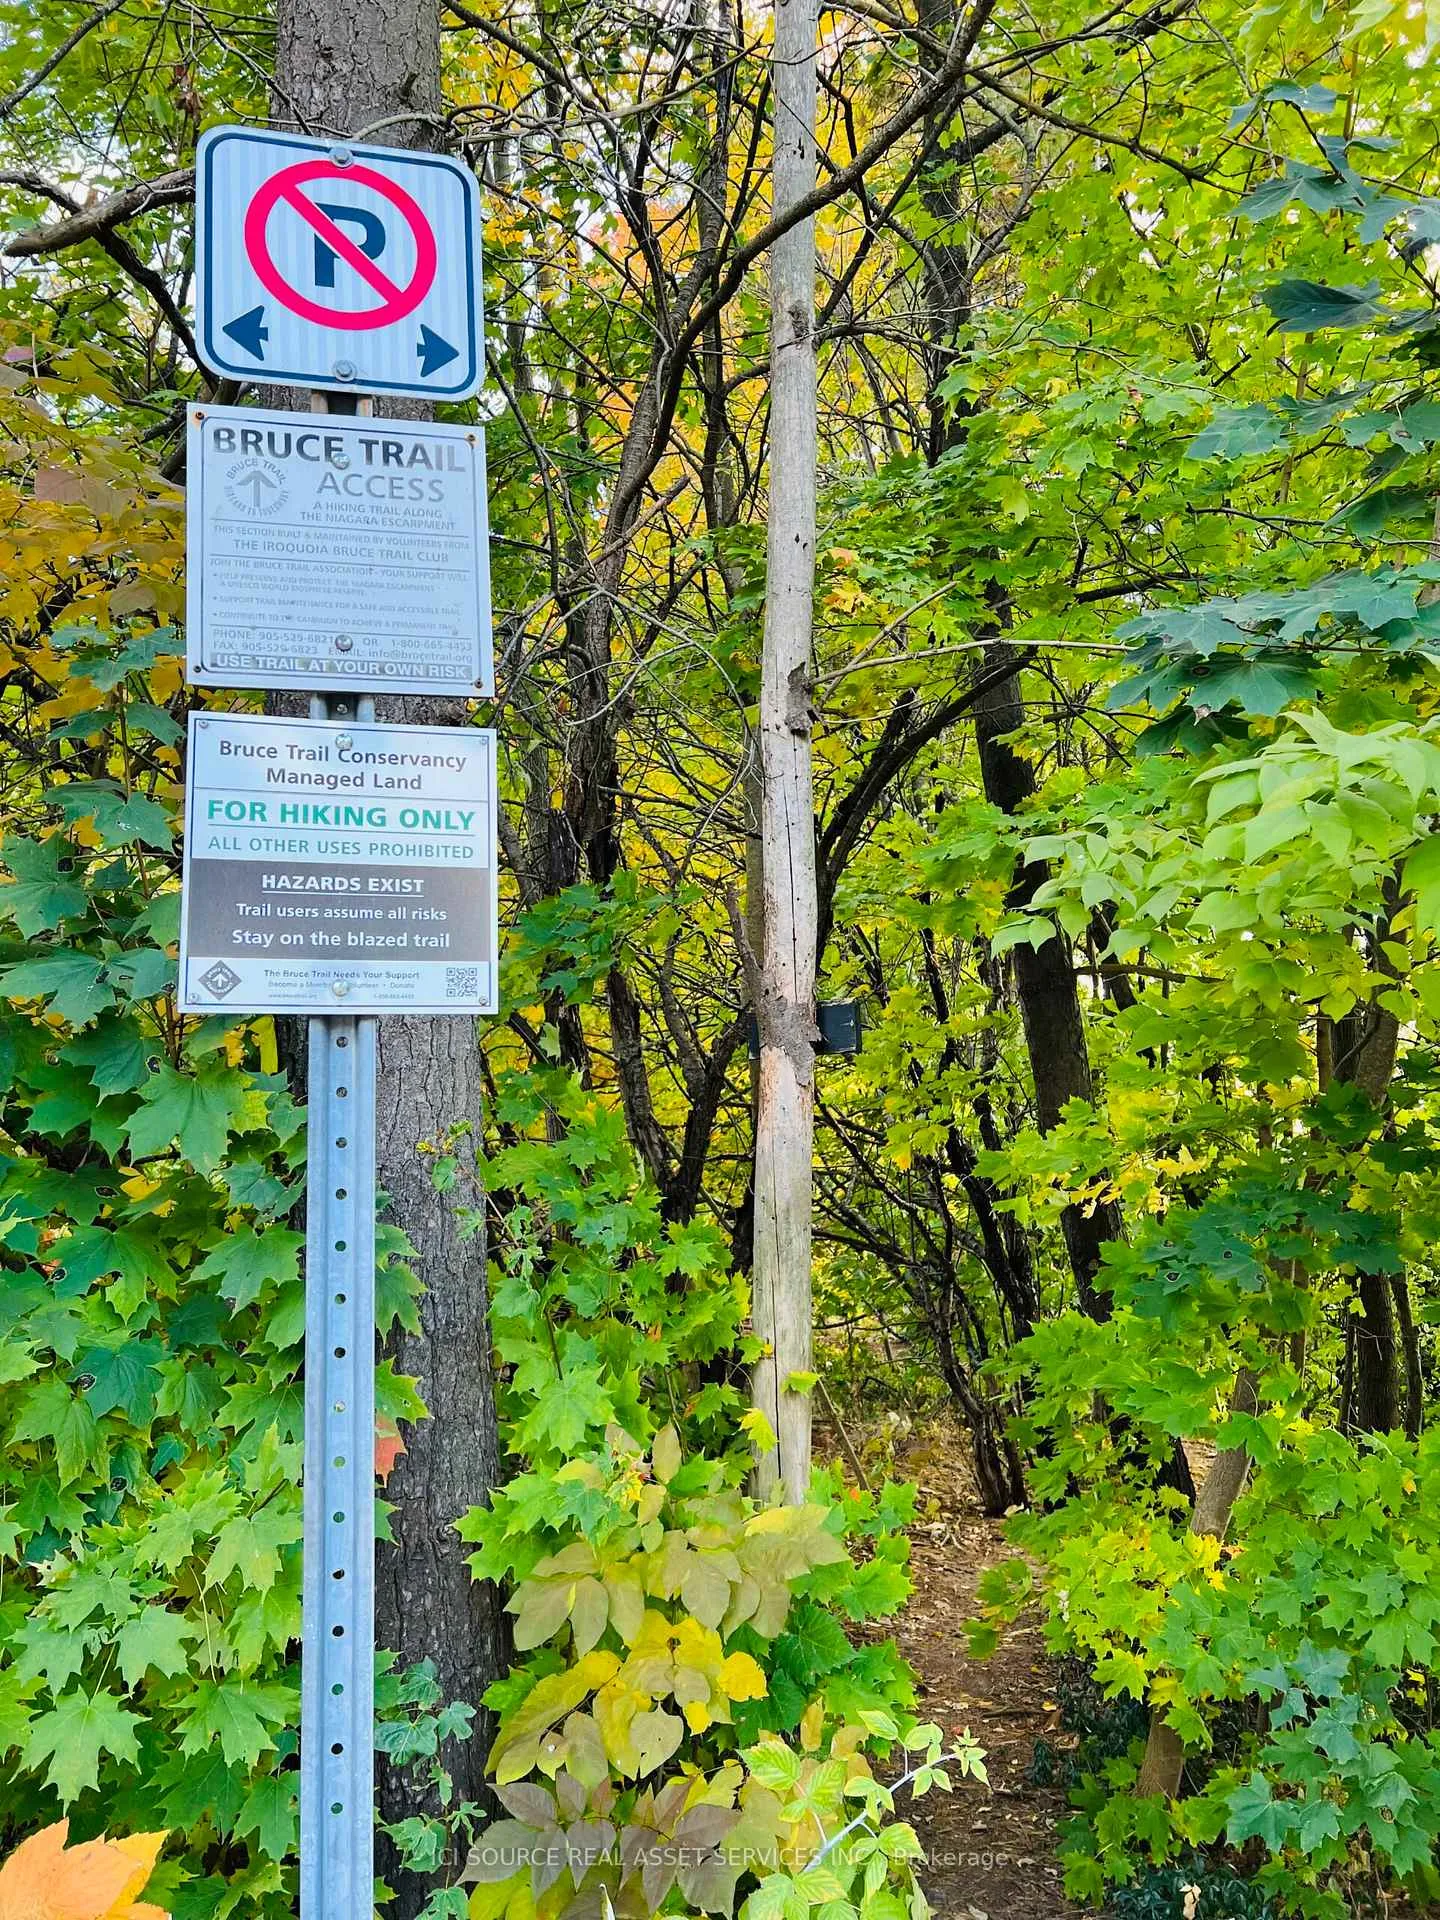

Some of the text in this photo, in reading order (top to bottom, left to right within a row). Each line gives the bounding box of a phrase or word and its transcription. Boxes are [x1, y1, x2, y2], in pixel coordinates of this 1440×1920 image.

[314, 202, 386, 288] P
[213, 427, 466, 473] BRUCE TRAIL
[226, 457, 288, 485] BRUCE TRAIL
[316, 471, 445, 503] ACCESS
[300, 511, 456, 530] THE NIAGARA ESCARPMENT
[311, 501, 443, 518] A HIKING TRAIL ALONG
[214, 525, 234, 535] THIS
[236, 526, 275, 537] SECTION
[277, 528, 302, 538] BUILT
[314, 531, 371, 544] MAINTAINED
[374, 533, 385, 544] BY
[386, 535, 442, 548] VOLUNTEERS
[443, 540, 470, 550] FROM
[233, 539, 449, 563] THE IROQUOIA BRUCE TRAIL CLUB
[253, 560, 282, 570] BRUCE
[381, 568, 404, 579] YOUR
[406, 569, 445, 581] SUPPORT
[362, 637, 378, 646] OR
[216, 654, 467, 678] USE TRAIL AT YOUR OWN RISK
[219, 740, 467, 772] Bruce Trail Conservancy
[266, 768, 423, 790] Managed Land
[208, 799, 475, 831] FOR HIKING ONLY
[208, 836, 474, 859] ALL OTHER USES PROHIBITED
[262, 874, 424, 893] HAZARDS EXIST
[236, 903, 448, 921] Trail users assume all risks
[232, 929, 450, 948] Stay on the blazed trail
[264, 969, 419, 981] The Bruce Trail Needs Your Support
